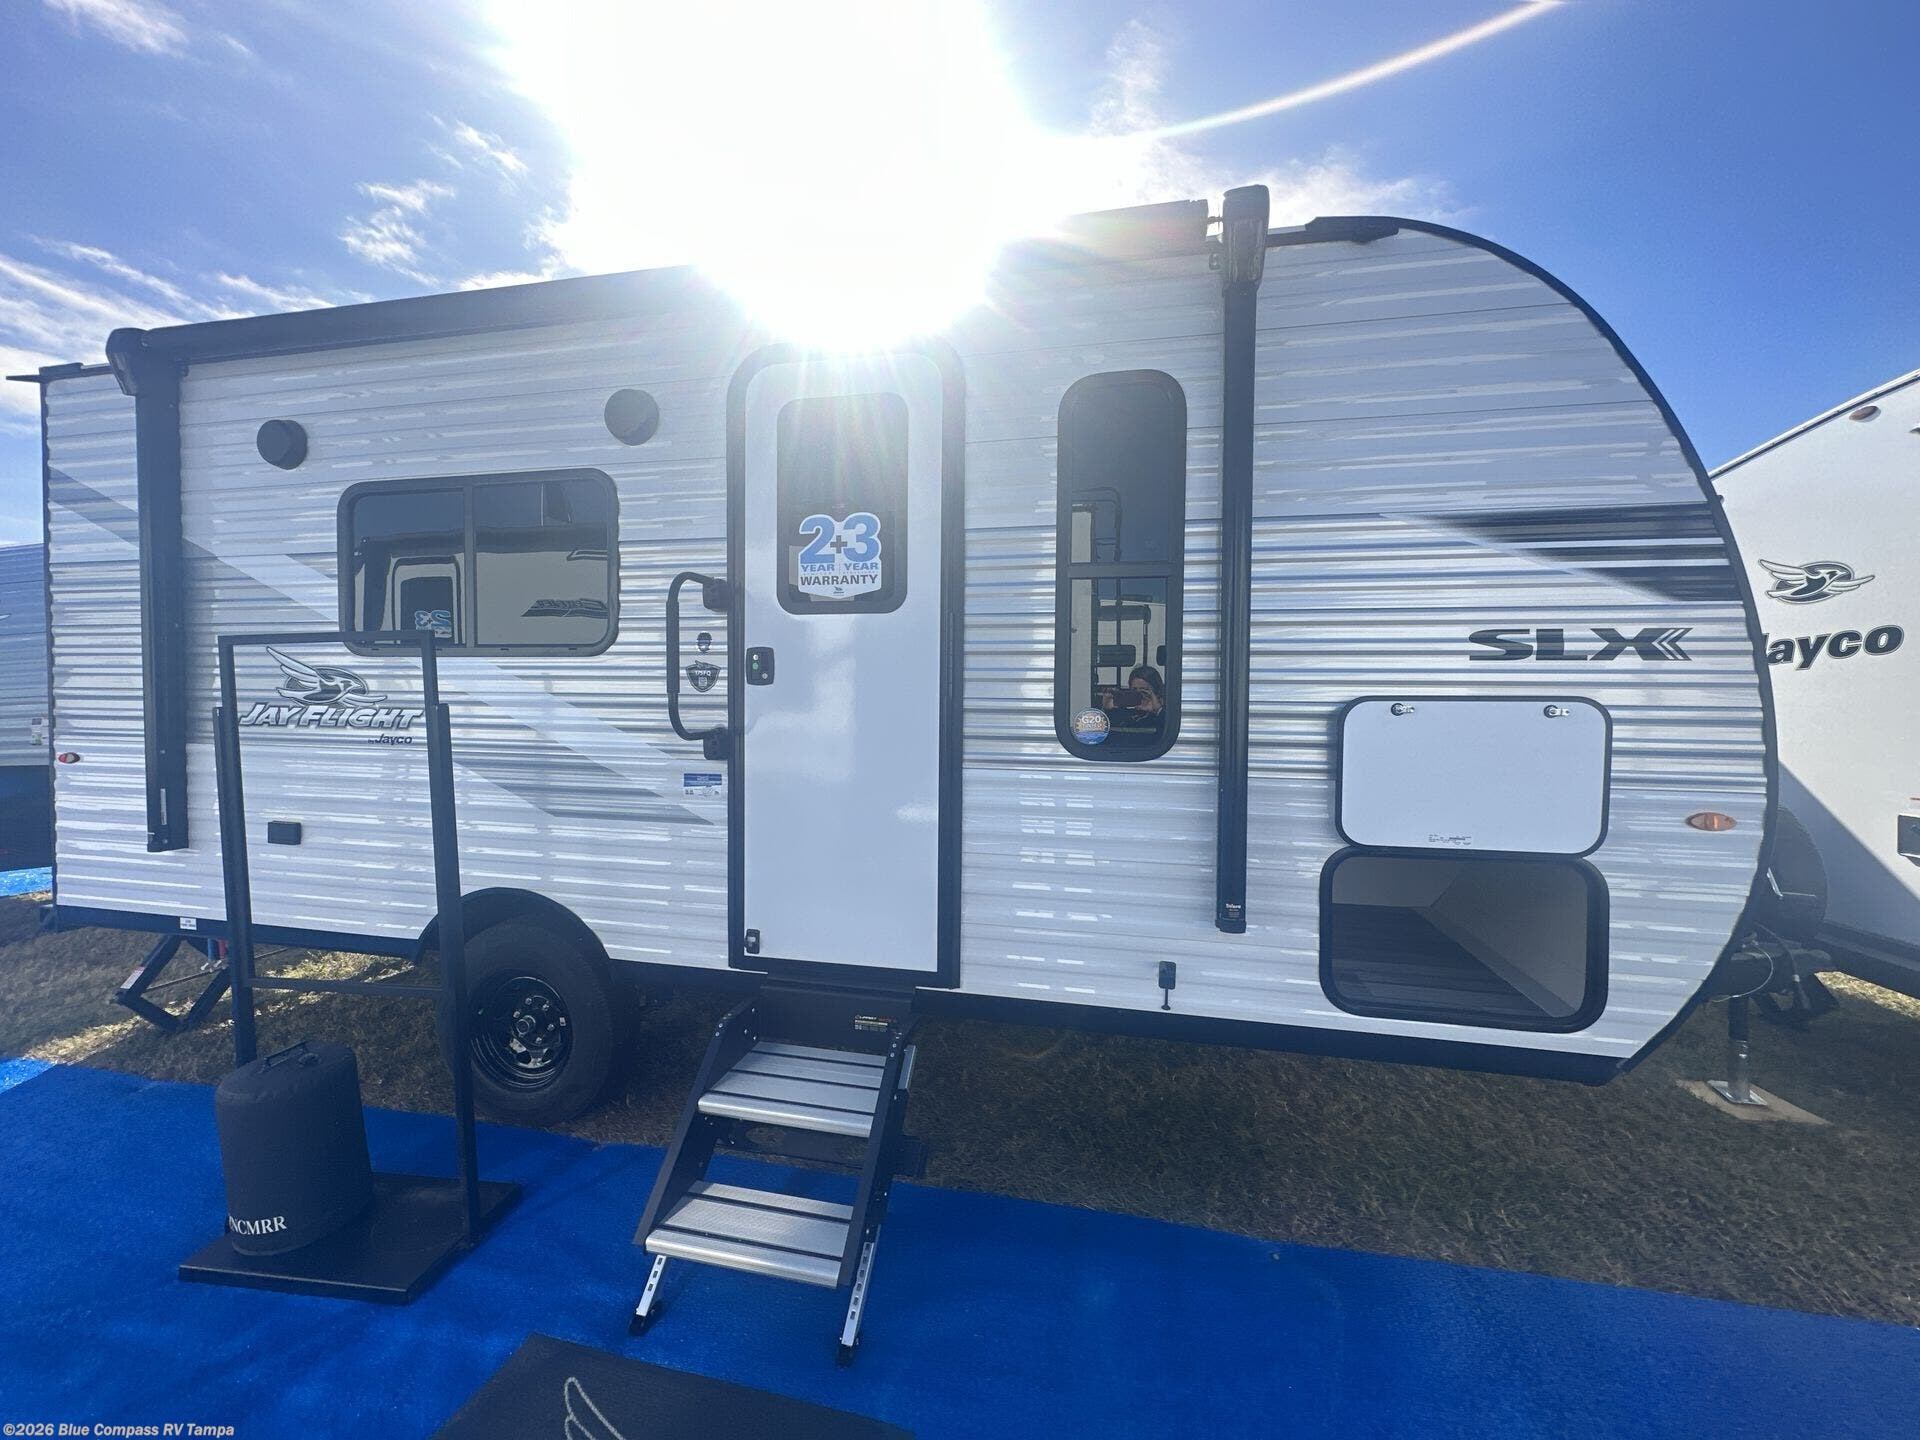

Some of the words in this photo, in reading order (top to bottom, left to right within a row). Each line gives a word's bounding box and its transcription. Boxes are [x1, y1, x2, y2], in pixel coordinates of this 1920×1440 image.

[801, 564, 835, 572] YEAR
[843, 562, 879, 571] YEAR
[800, 574, 879, 586] WARRANTY
[1468, 627, 1694, 661] SLX
[239, 701, 302, 727] JAY
[301, 704, 425, 730] FLIGHT
[375, 733, 413, 746] Jayco
